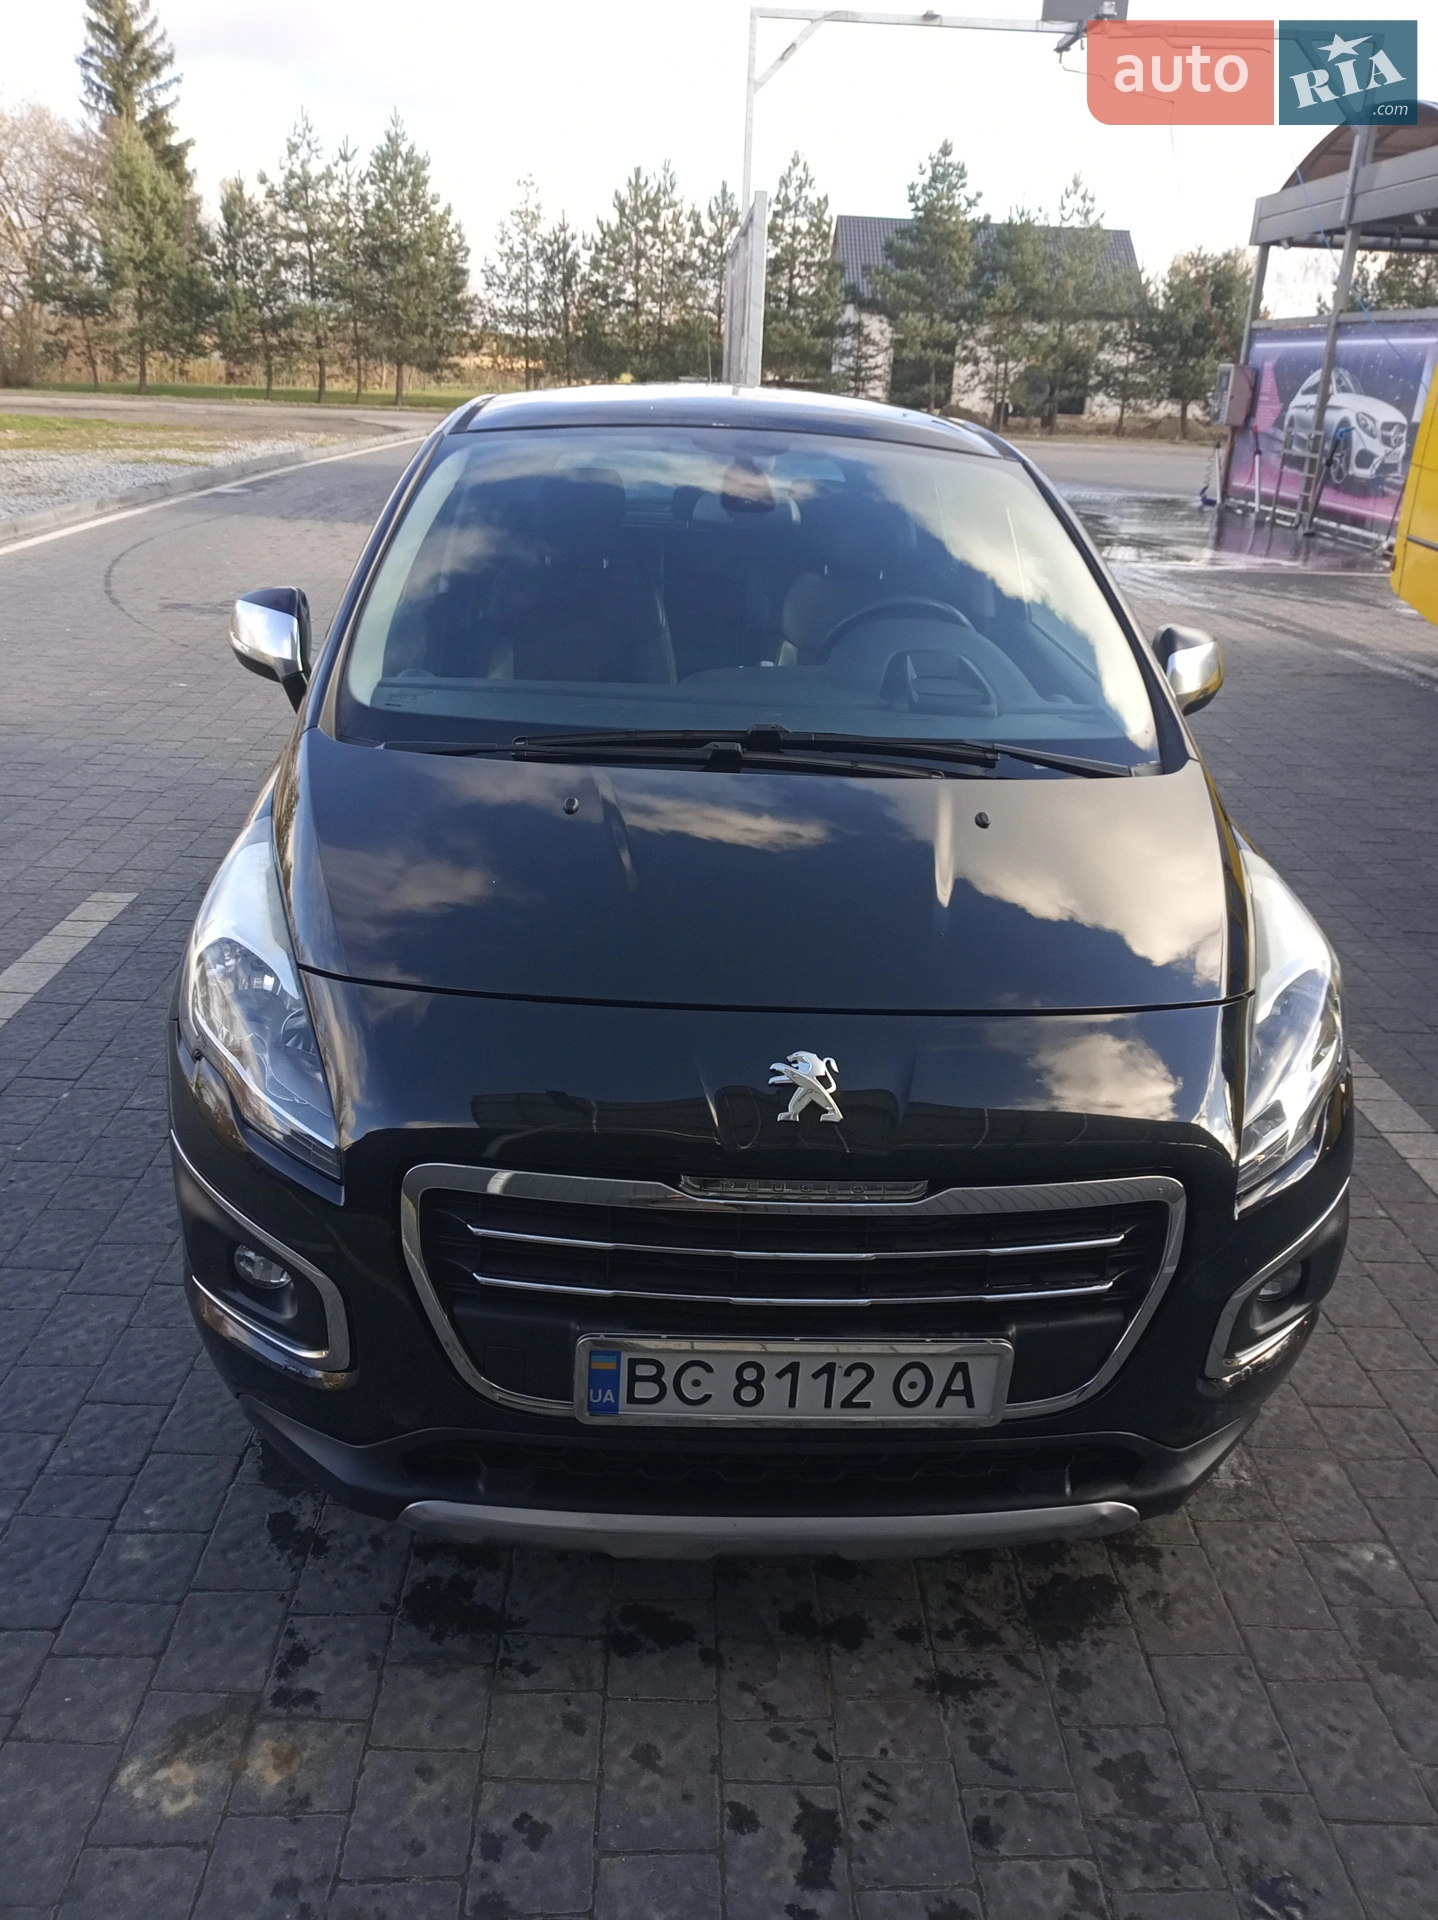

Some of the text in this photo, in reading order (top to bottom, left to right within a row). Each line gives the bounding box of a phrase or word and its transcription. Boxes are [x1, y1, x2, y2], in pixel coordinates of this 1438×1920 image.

[719, 1180, 892, 1195] PEUGEOT
[626, 1357, 976, 1409] BC 8112 OA
[589, 1388, 615, 1404] UA
